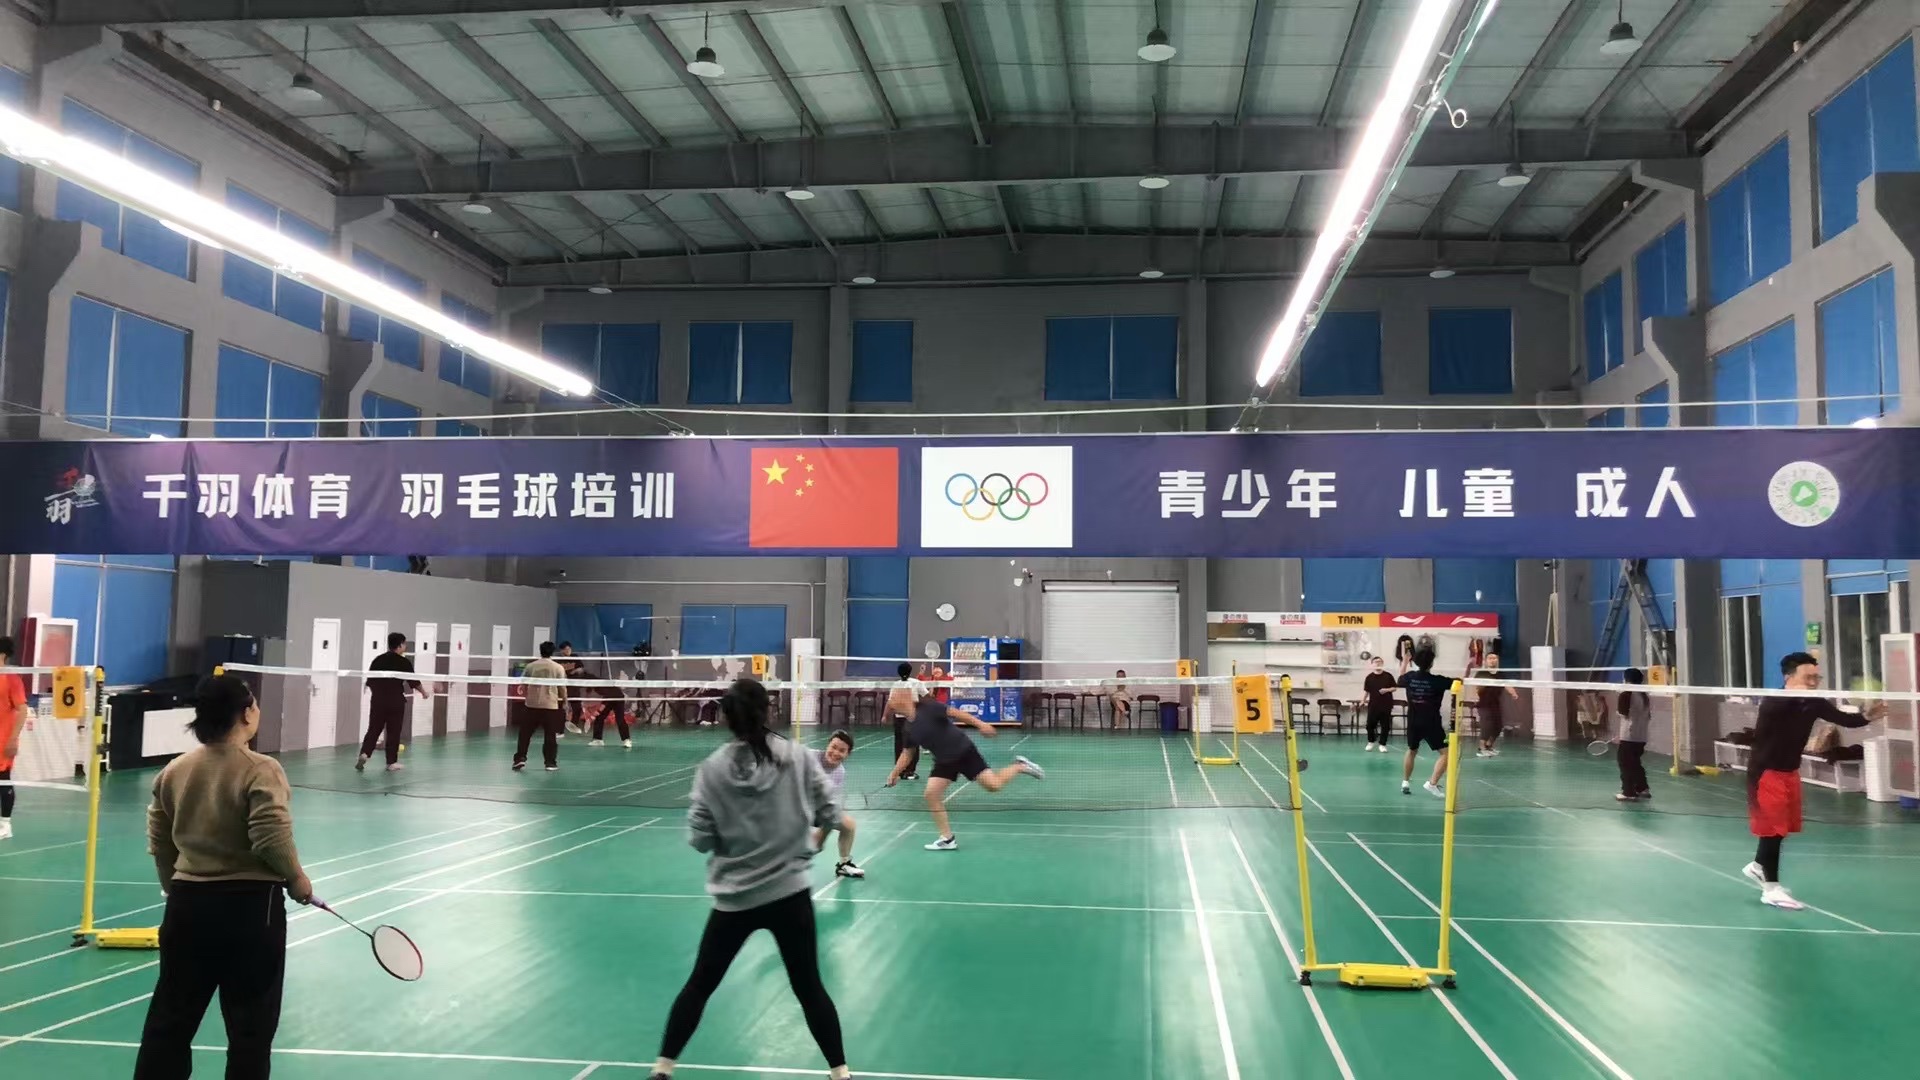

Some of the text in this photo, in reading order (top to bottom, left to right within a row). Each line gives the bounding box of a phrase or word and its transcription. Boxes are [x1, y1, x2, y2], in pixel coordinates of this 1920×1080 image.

[142, 472, 675, 519] 千羽体育 羽毛球培训
[1158, 466, 1696, 519] 青少年 儿童 成人
[1337, 615, 1364, 625] TAAN
[1181, 667, 1186, 676] 2
[62, 686, 75, 706] 6
[1246, 699, 1261, 721] 5
